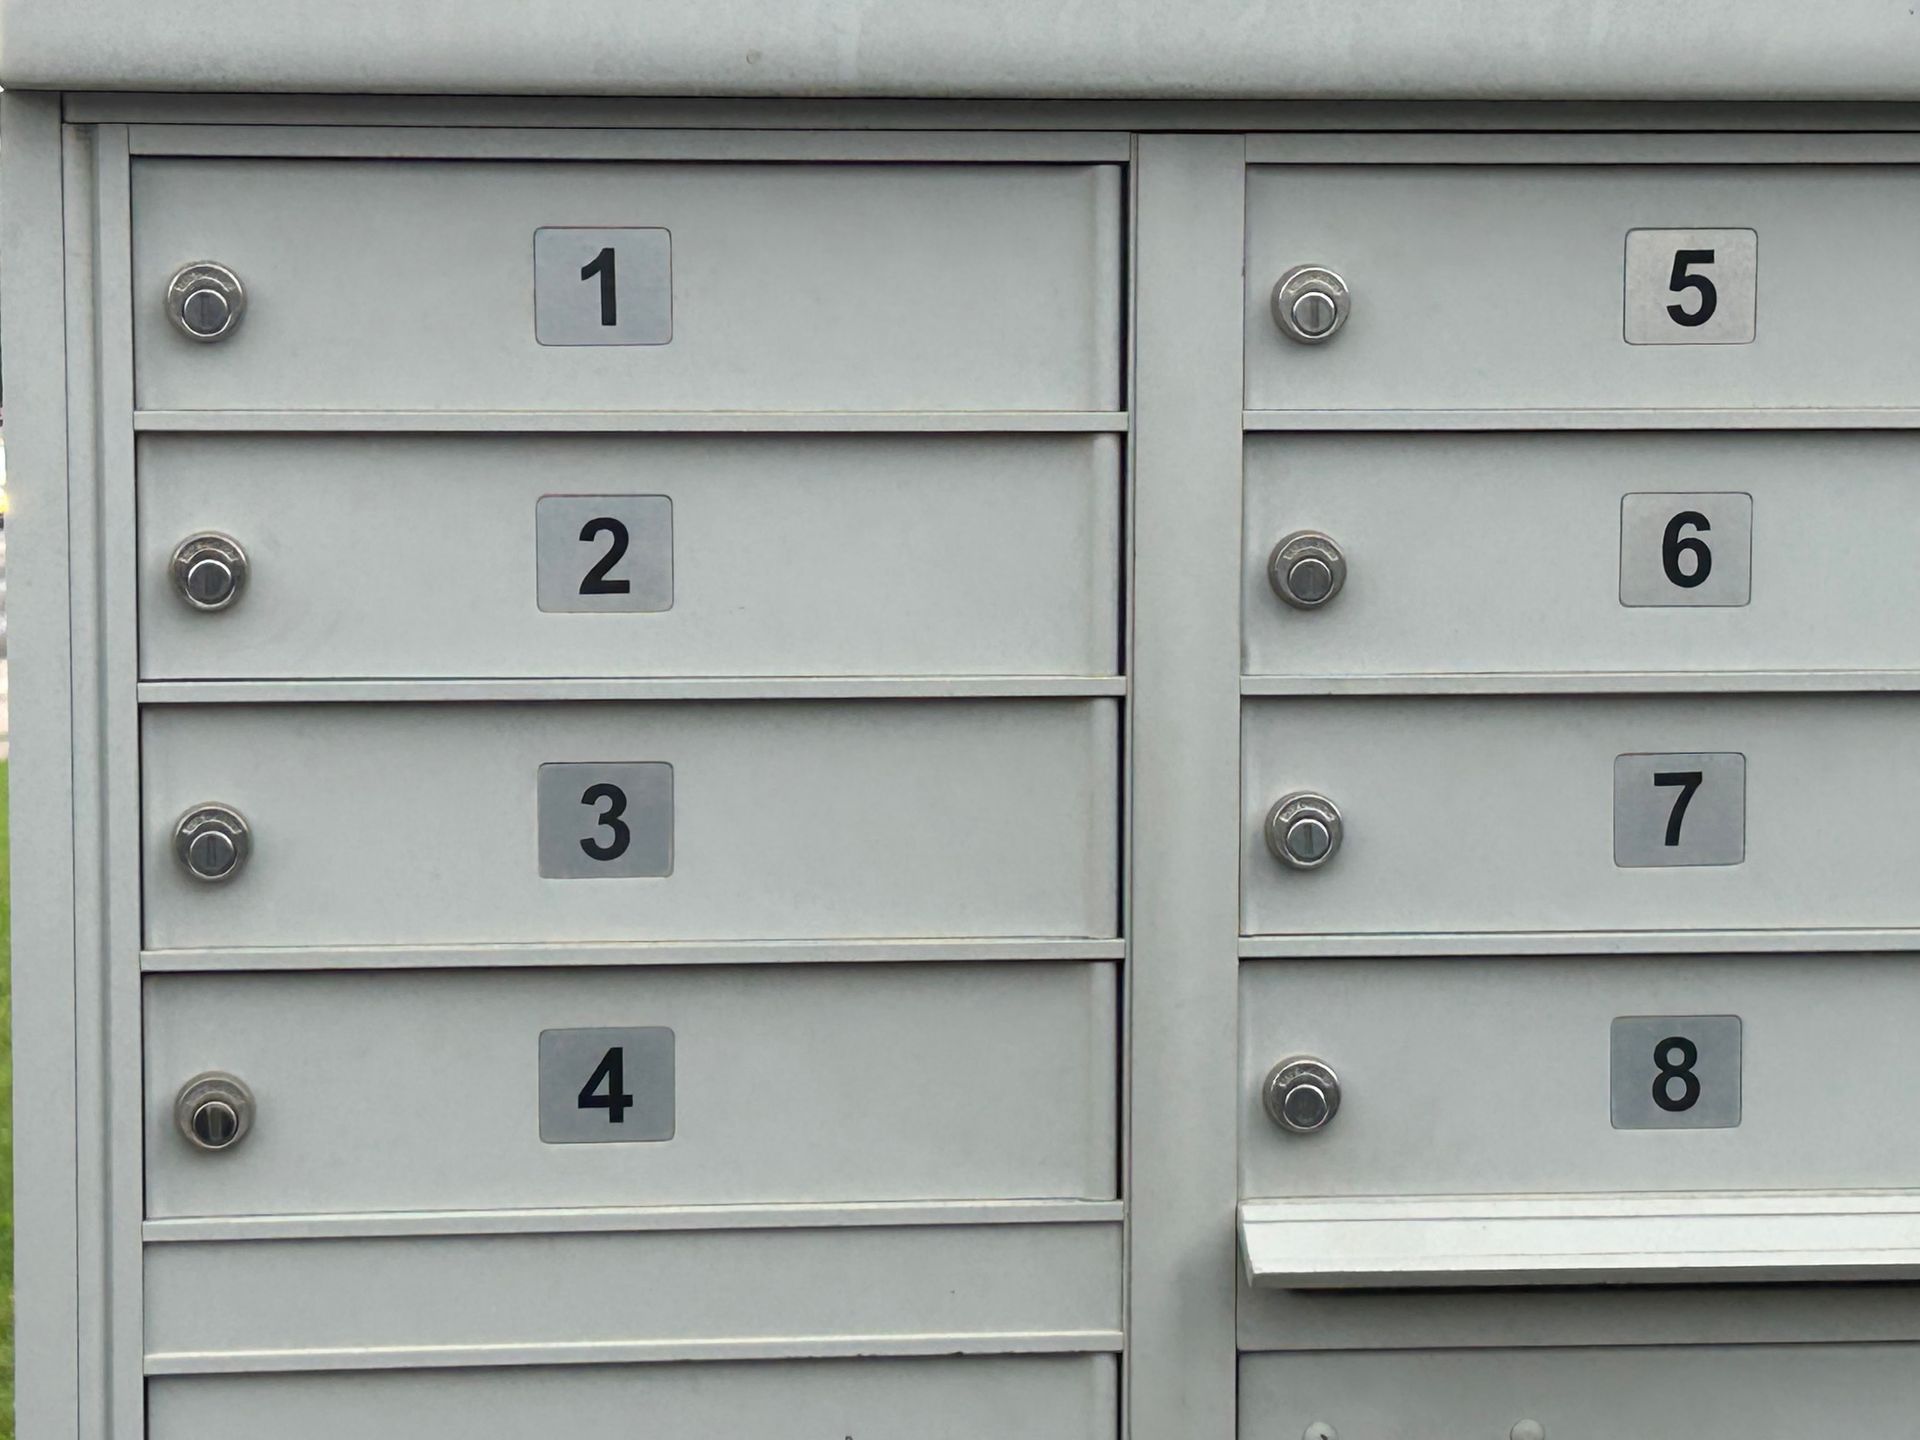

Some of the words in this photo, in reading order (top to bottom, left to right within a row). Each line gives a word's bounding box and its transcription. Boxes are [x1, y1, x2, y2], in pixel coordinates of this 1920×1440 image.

[581, 248, 616, 326] 1
[1667, 250, 1717, 326] 5
[579, 517, 630, 594] 2
[1663, 511, 1712, 588] 6
[580, 783, 630, 861] 3
[1654, 771, 1702, 846] 7
[578, 1047, 633, 1123] 4
[1652, 1037, 1700, 1112] 8
